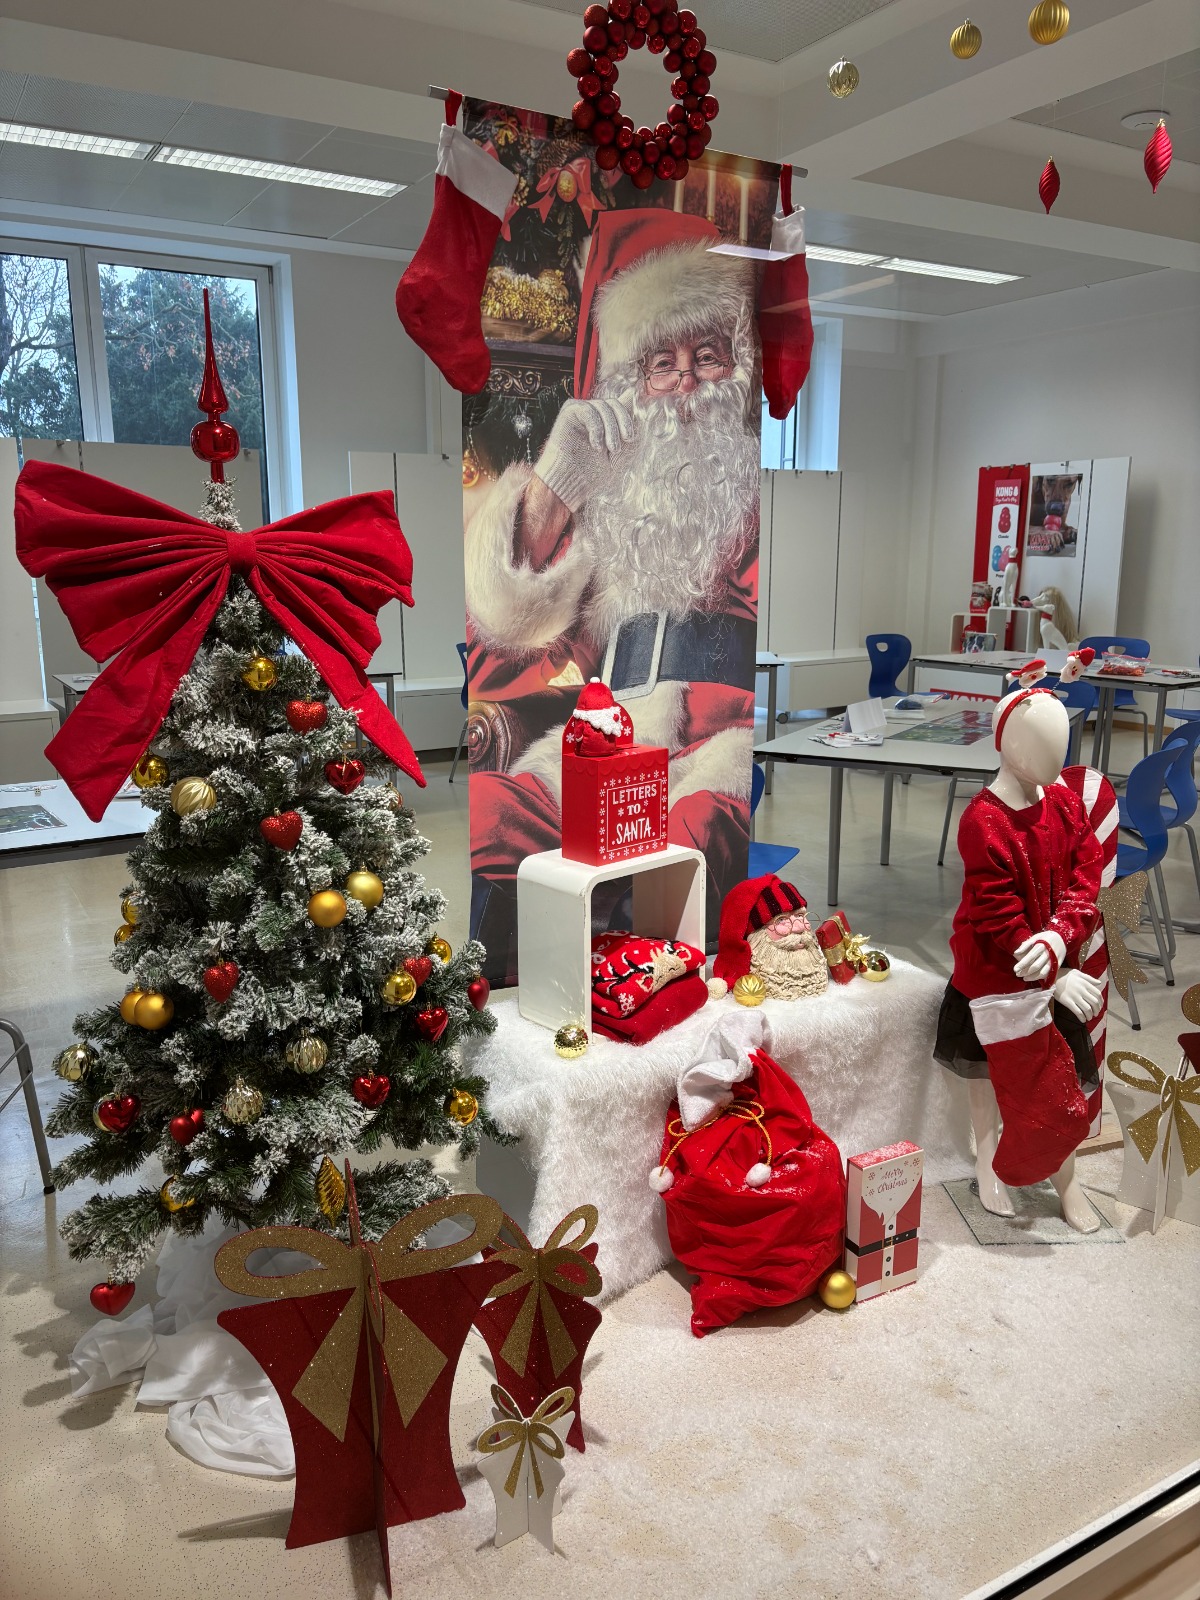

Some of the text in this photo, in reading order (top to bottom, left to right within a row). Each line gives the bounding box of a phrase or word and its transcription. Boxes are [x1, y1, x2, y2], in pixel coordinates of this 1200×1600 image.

[995, 486, 1013, 497] KONG
[612, 783, 657, 805] LETTERS
[627, 803, 641, 816] TO
[616, 817, 652, 845] SANTA
[881, 1168, 904, 1180] Merry
[877, 1178, 908, 1194] Christmas
